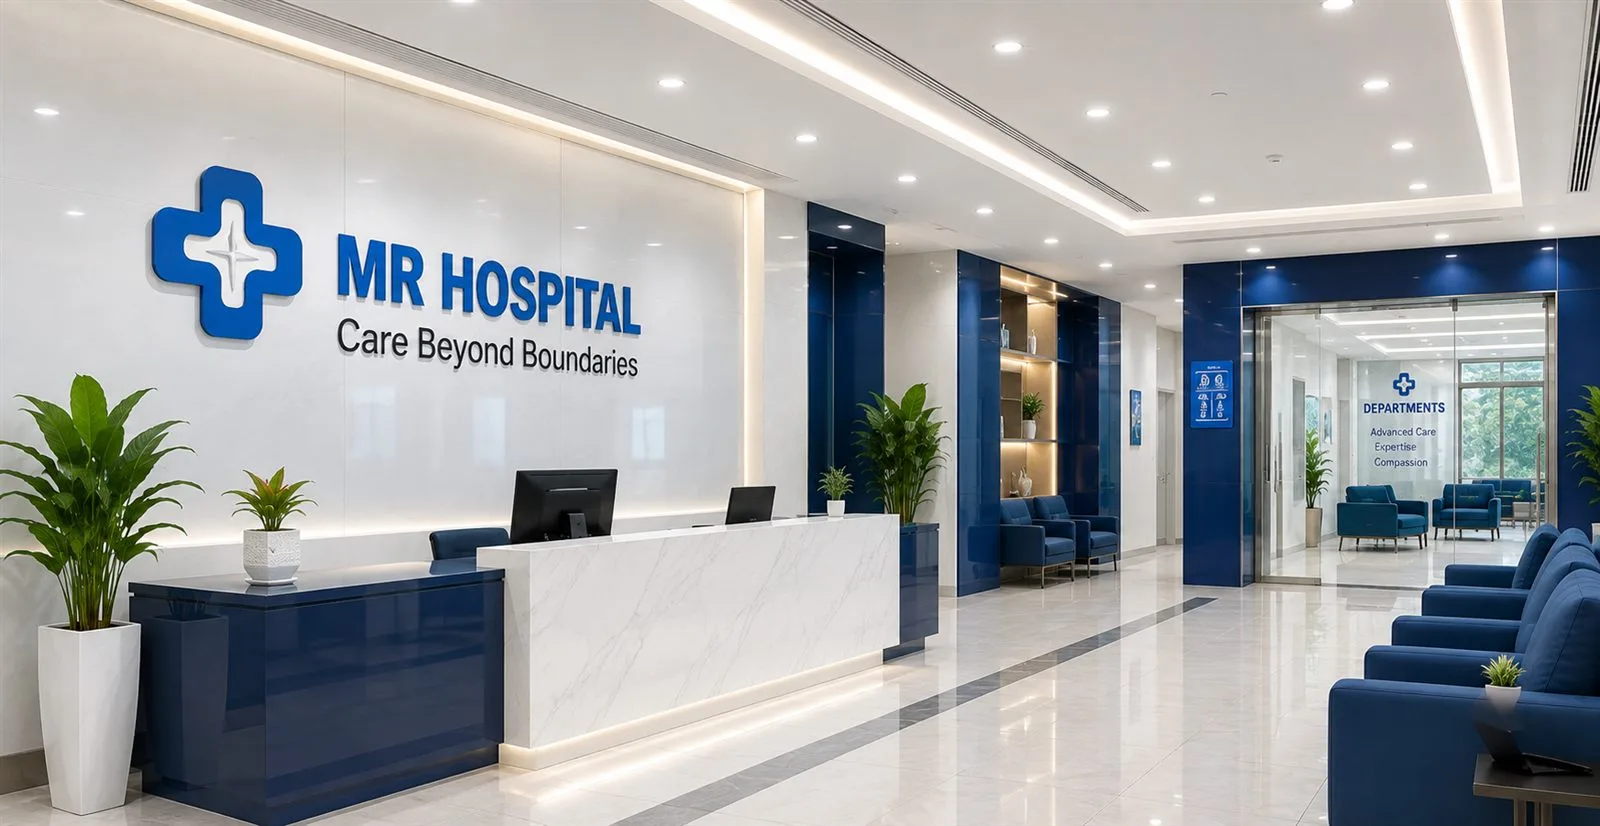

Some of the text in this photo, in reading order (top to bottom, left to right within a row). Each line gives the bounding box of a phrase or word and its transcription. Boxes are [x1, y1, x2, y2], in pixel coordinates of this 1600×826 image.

[338, 234, 641, 335] MR HOSPITAL
[337, 318, 638, 377] Care Beyond Boundaries
[1363, 402, 1446, 414] DEPARTMENTS
[1370, 427, 1437, 437] Advanced Care
[1374, 442, 1417, 453] Expertise
[1374, 457, 1428, 468] Compassion
